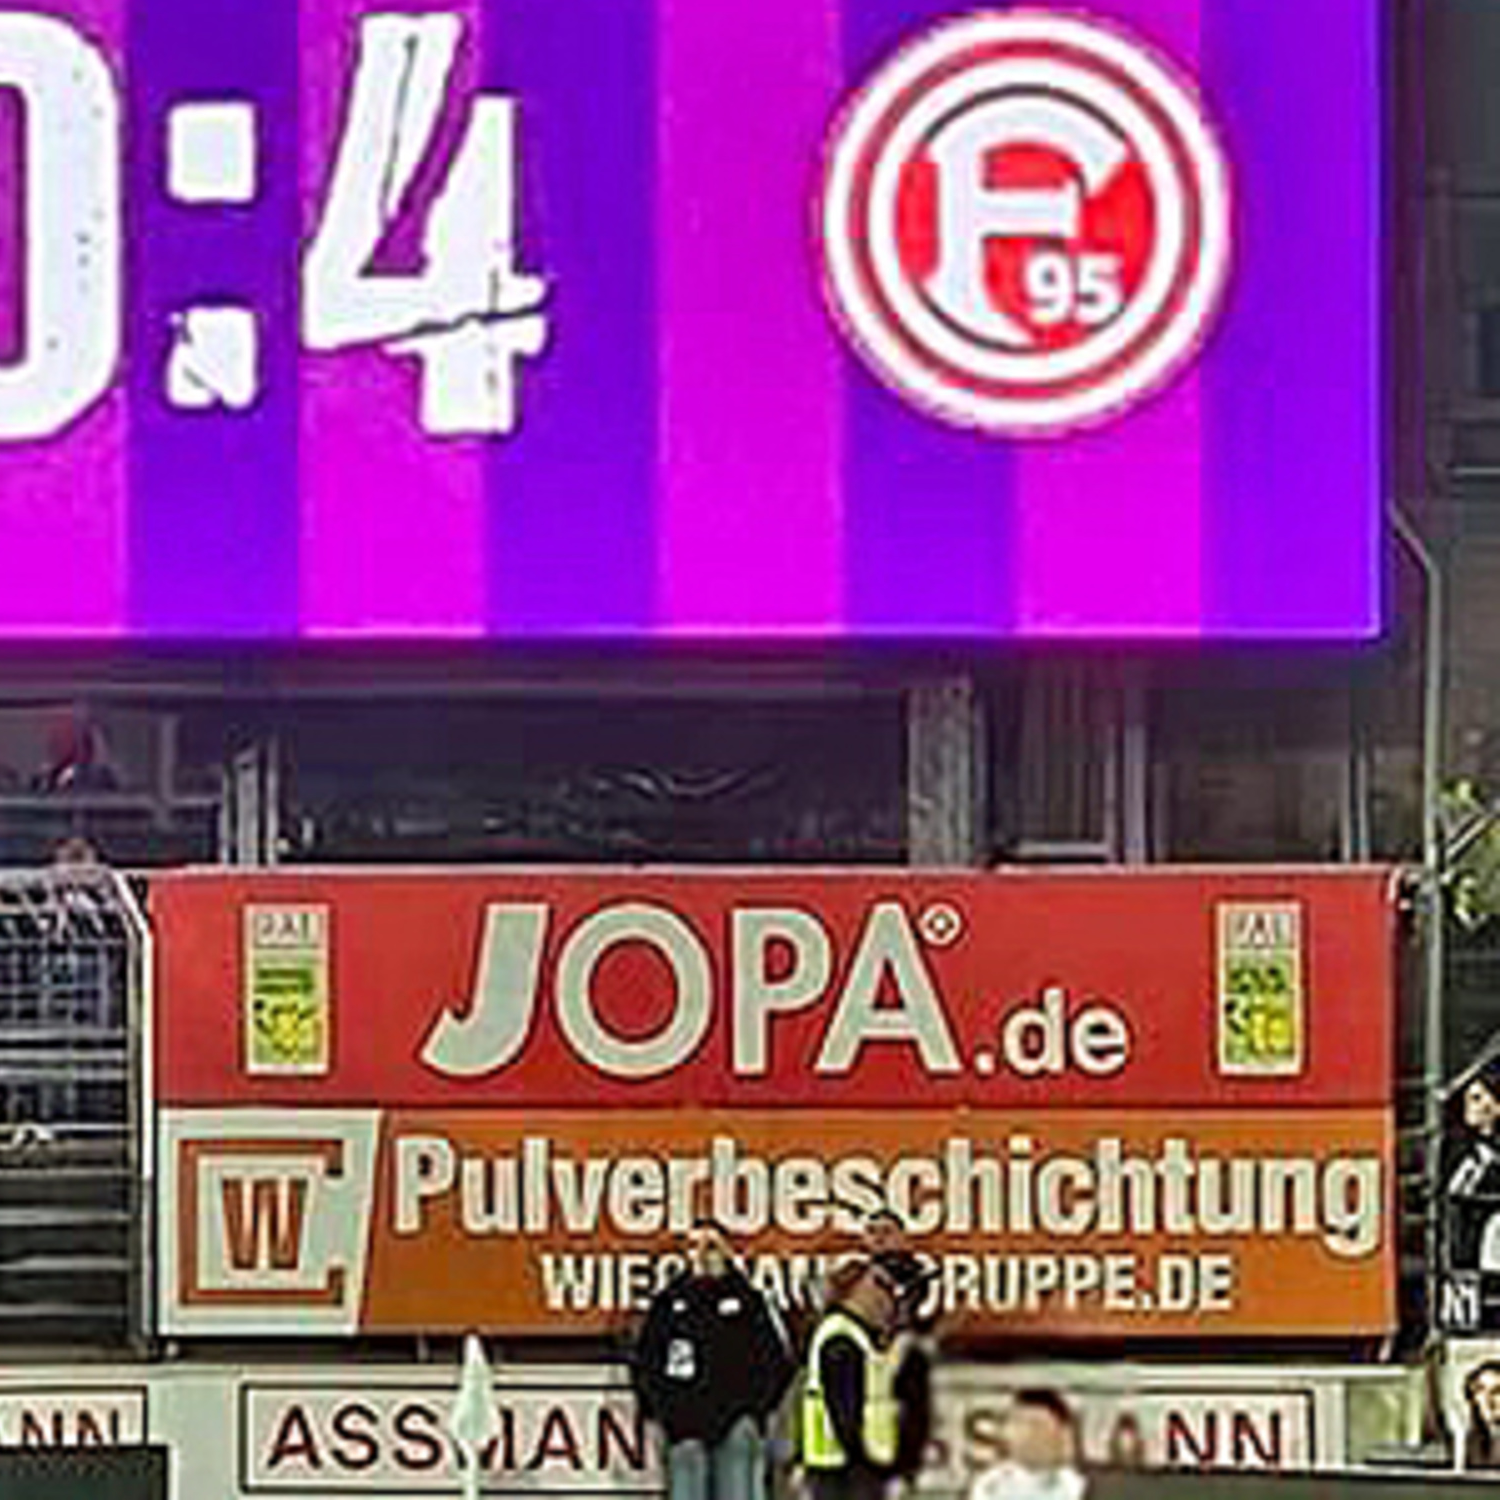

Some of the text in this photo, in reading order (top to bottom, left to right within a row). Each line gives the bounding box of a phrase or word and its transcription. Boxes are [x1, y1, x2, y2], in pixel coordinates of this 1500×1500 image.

[1024, 252, 1125, 325] 95
[395, 1135, 1381, 1256] Pulverbeschichtung
[267, 1404, 646, 1471] ASSMAN
